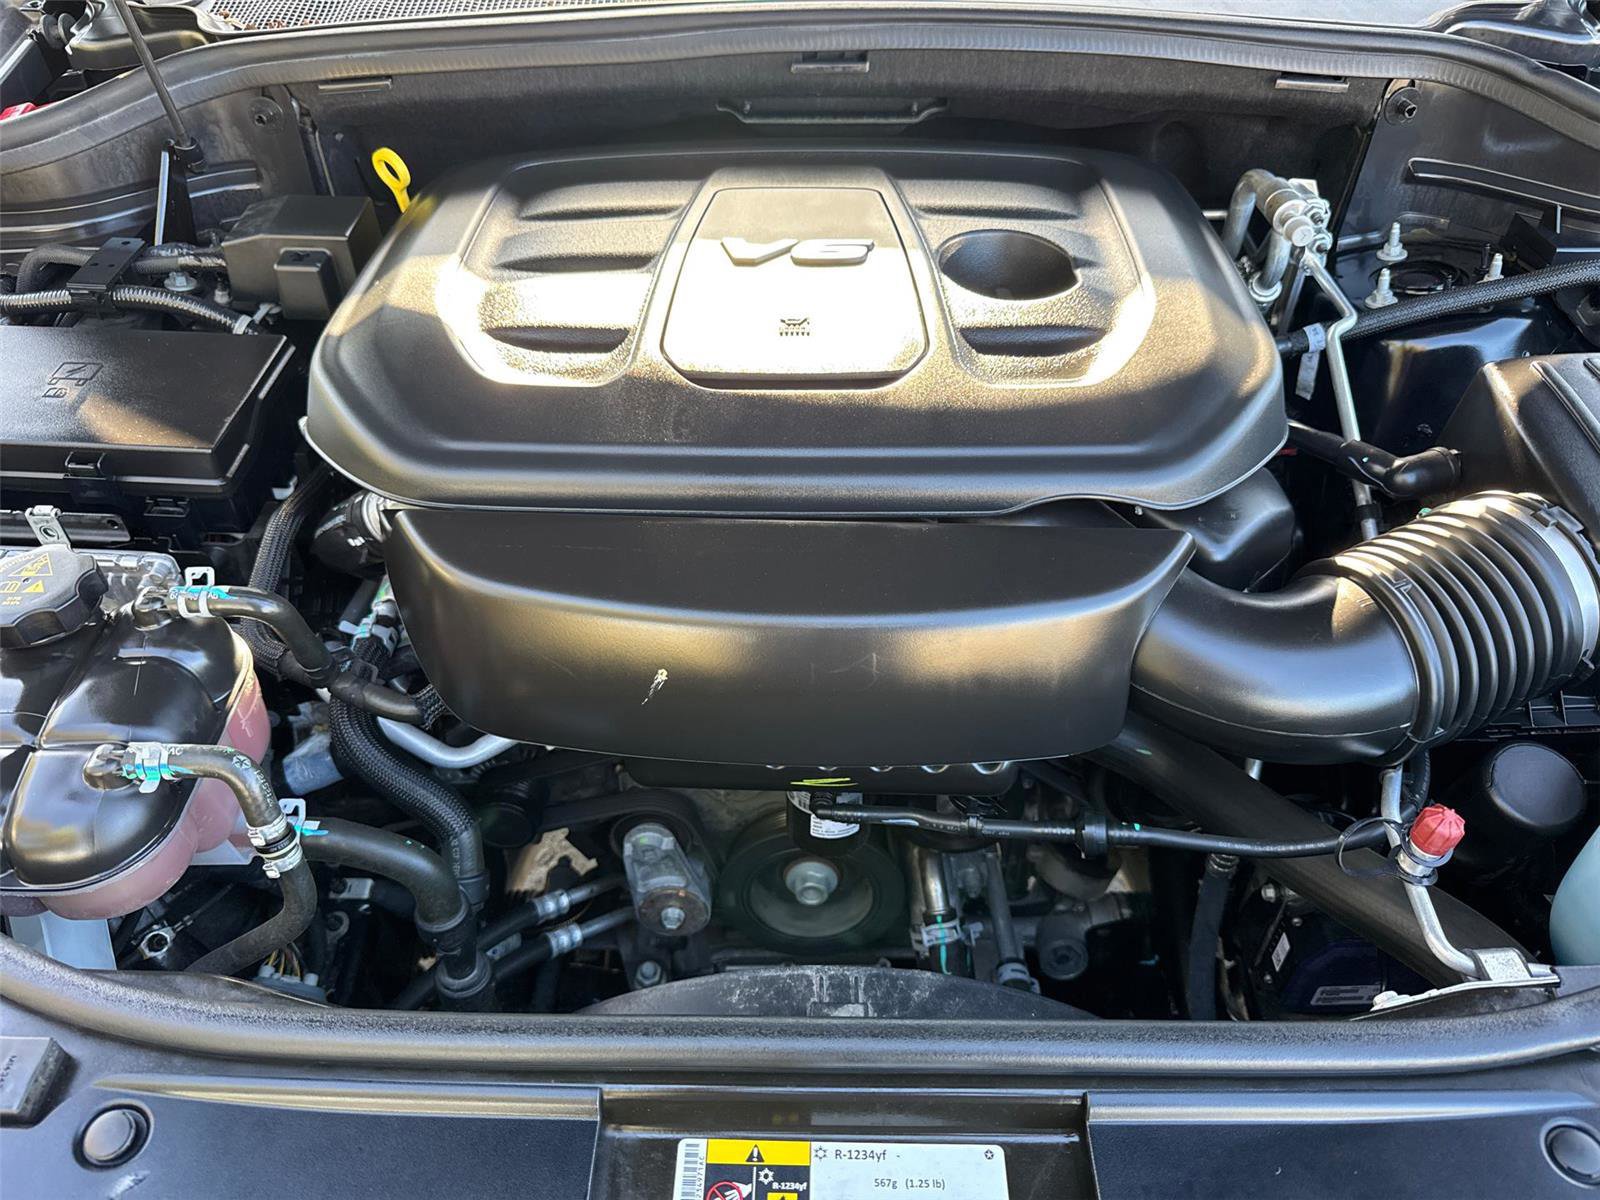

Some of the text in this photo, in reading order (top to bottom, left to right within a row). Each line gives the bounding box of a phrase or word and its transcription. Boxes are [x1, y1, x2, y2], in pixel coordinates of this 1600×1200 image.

[720, 237, 875, 267] V6
[834, 1149, 887, 1163] R-1234yf
[772, 1181, 808, 1192] R-1234yf
[874, 1178, 946, 1191] 567g (1.25 lb)
